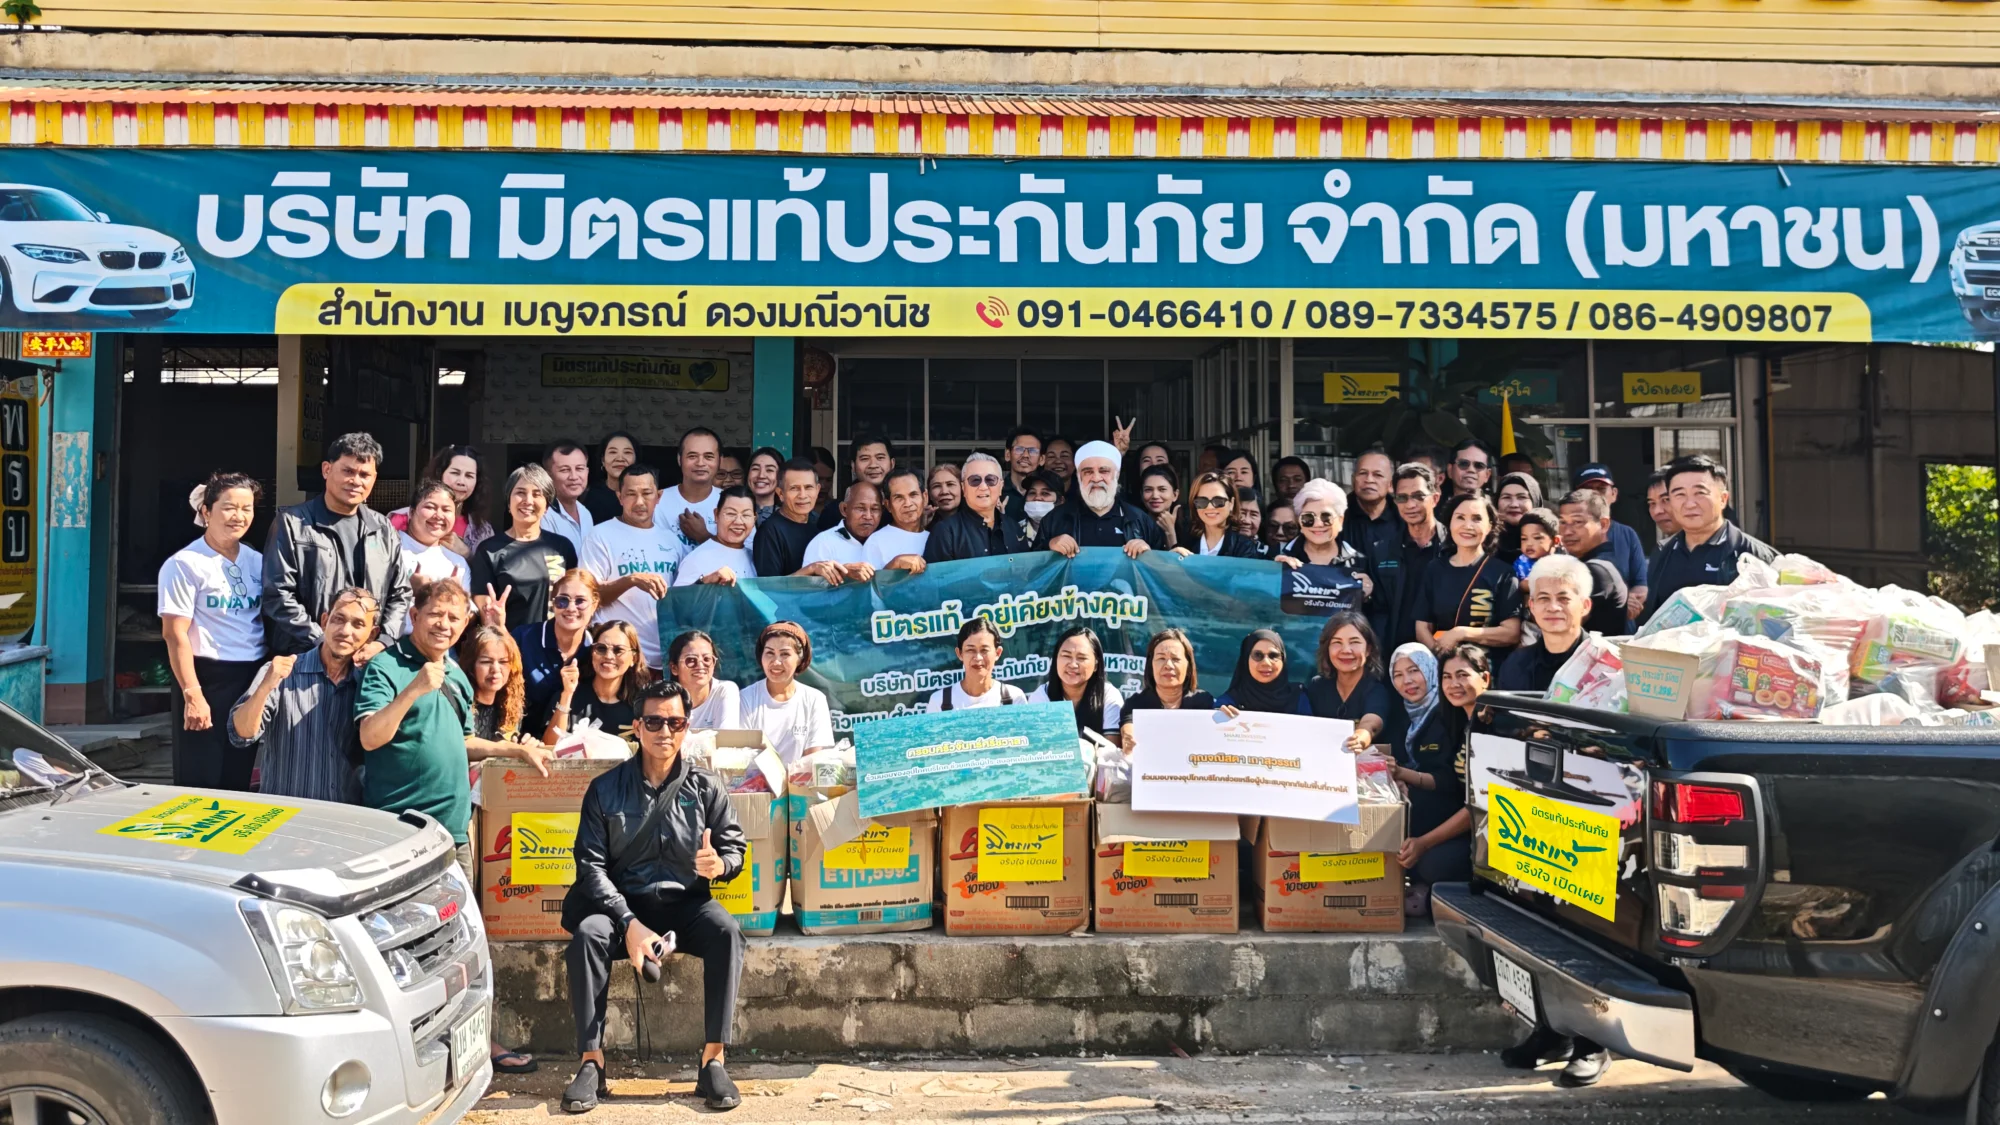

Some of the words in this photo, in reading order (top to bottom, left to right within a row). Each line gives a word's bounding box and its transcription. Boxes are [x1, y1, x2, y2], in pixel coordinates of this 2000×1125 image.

[197, 166, 471, 260] บริษัท
[498, 167, 1264, 265] มิตรแท้ประกันภัย
[1287, 168, 1540, 265] จำกัด
[1565, 190, 1941, 283] (มหาชน)
[318, 287, 484, 327] สำนักงาน
[503, 290, 687, 333] เบญจภรณ์
[706, 293, 931, 329] ดวงมณีวานิช
[1016, 299, 1273, 330] 091-0466410
[1282, 300, 1295, 330] /
[1305, 300, 1557, 330] 089-7334575
[1566, 300, 1581, 330] /
[1588, 301, 1832, 333] 086-4909807
[552, 357, 681, 377] มิตรแท้ประกันภัย
[1631, 378, 1696, 396] เปิดเผย
[617, 560, 651, 577] DNA
[206, 594, 245, 609] DNA
[875, 604, 960, 638] มิตรแท้
[863, 669, 913, 692] บริษัท
[1494, 794, 1608, 867] มิตรแท้
[1531, 806, 1609, 839] มิตรแท้ประกันภัย
[983, 823, 1058, 851] มิตรแท้
[873, 845, 905, 854] เปิดเผย
[1145, 855, 1171, 863] จริงใจ
[1172, 855, 1204, 863] เปิดเผย
[534, 862, 560, 870] จริงใจ
[999, 858, 1025, 866] จริงใจ
[1026, 858, 1058, 866] เปิดเผย
[1322, 859, 1347, 867] จริงใจ
[1349, 856, 1380, 866] เปิดเผย
[1516, 861, 1550, 883] จริงใจ
[1553, 876, 1605, 906] เปิดเผย
[715, 892, 748, 901] เปิดเผย
